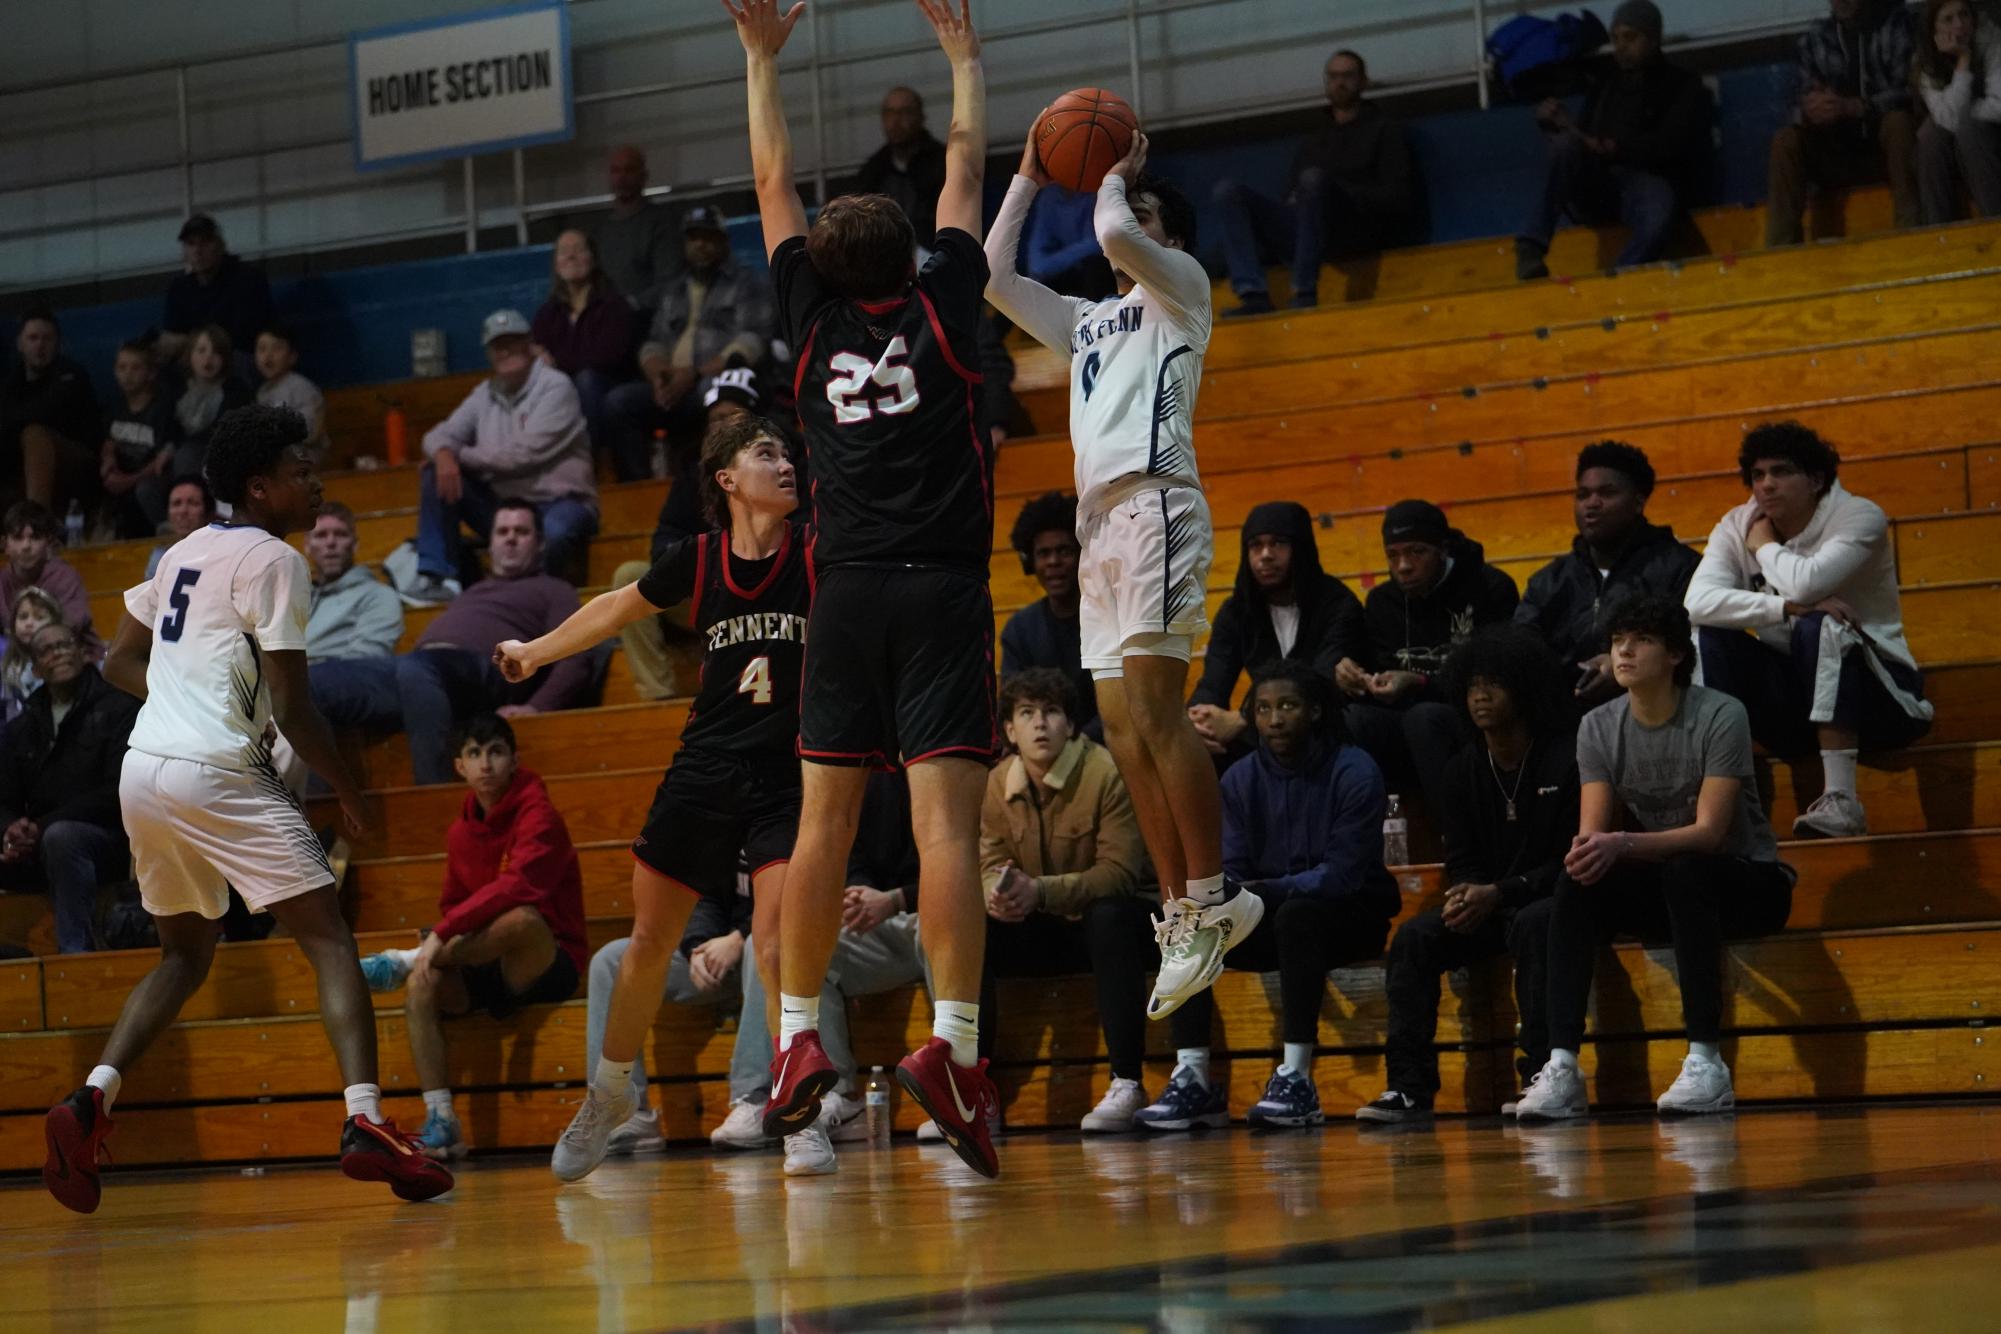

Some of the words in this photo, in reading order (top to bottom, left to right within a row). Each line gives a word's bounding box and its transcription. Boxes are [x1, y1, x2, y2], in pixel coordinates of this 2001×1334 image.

[368, 69, 440, 116] HOME
[446, 50, 551, 102] SECTION
[825, 333, 921, 425] 25
[160, 568, 202, 642] 5
[704, 612, 807, 652] TENNENT
[736, 655, 774, 705] 4
